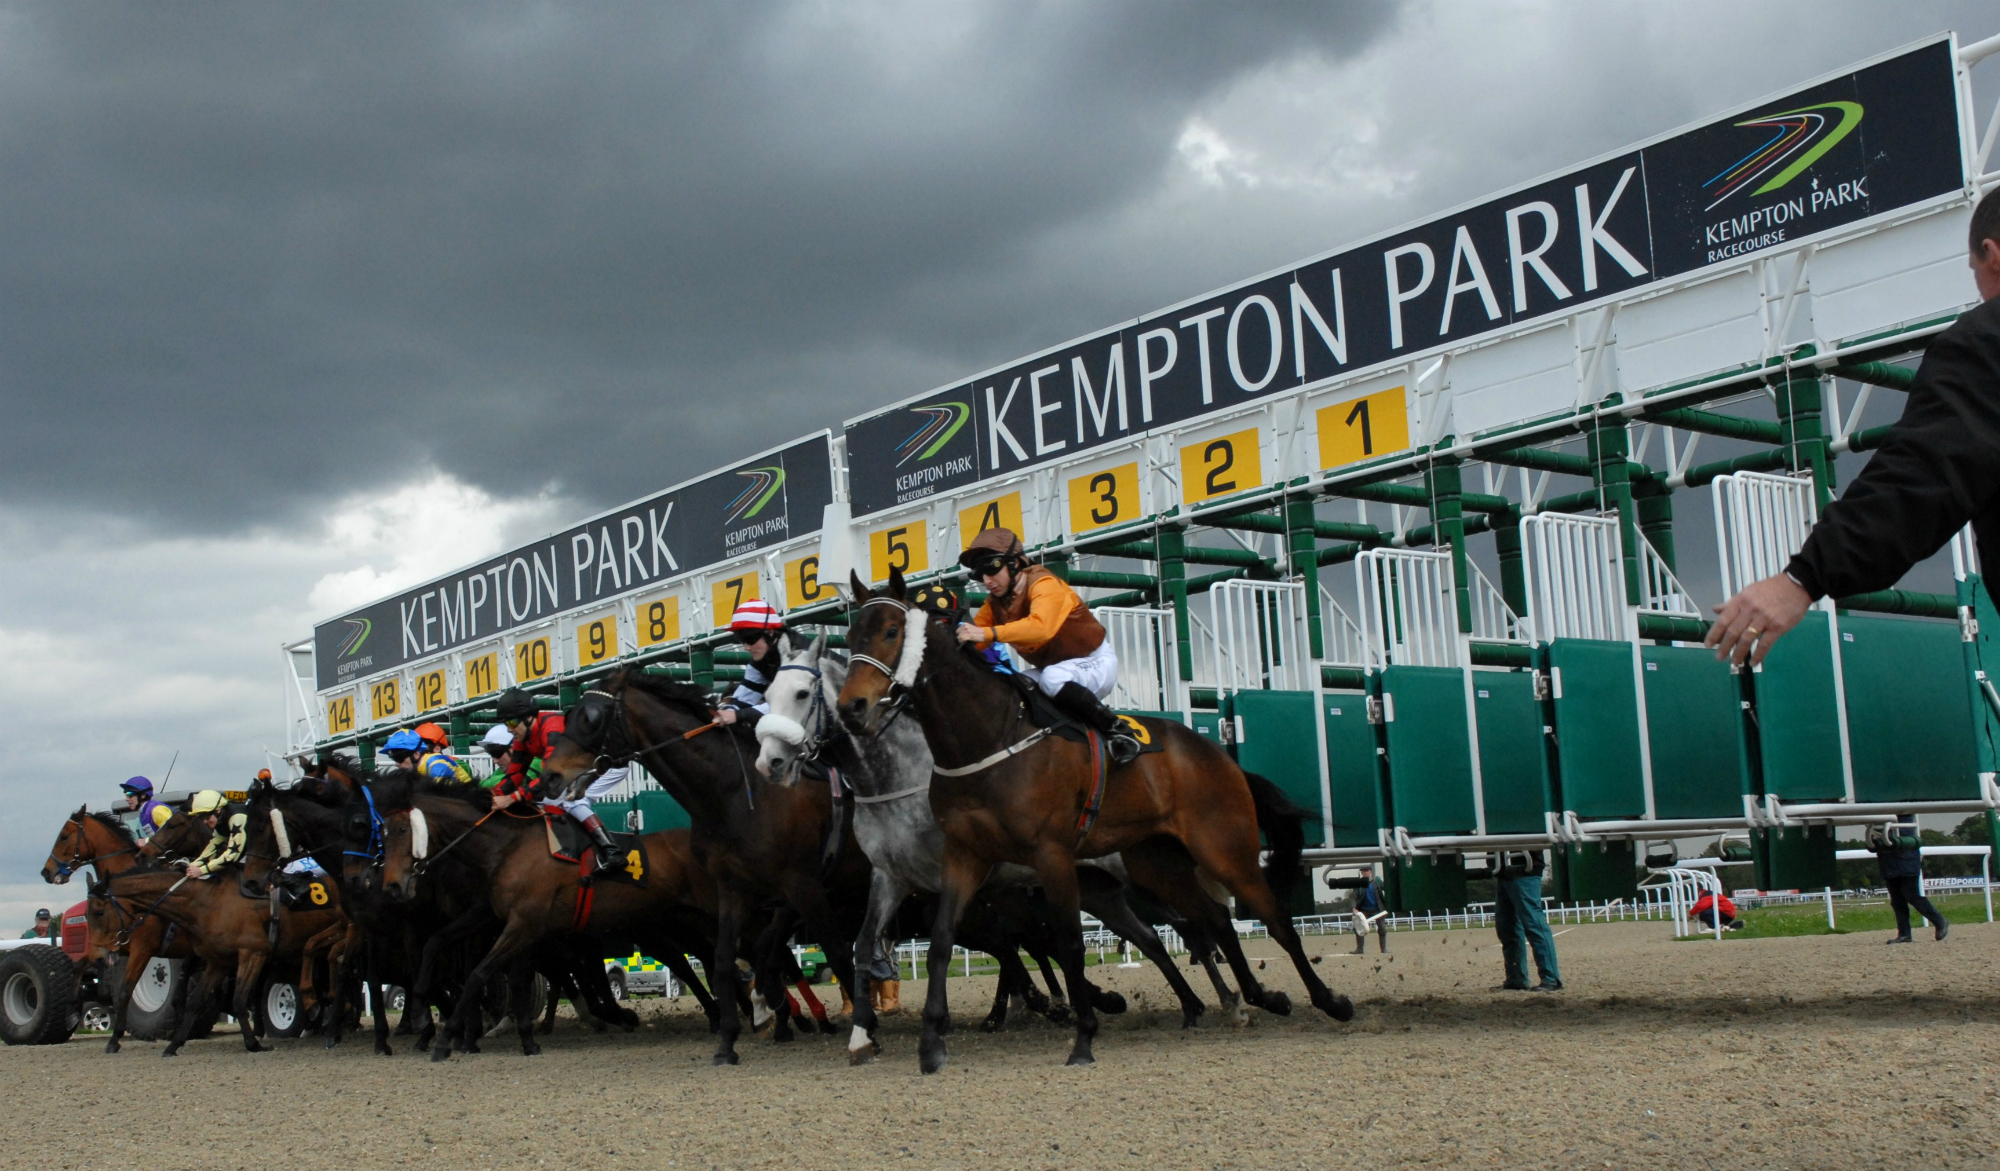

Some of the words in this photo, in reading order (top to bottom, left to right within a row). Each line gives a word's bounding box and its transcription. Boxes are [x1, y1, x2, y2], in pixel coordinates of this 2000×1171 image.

[1706, 197, 1804, 246] KEMPTON
[1811, 176, 1869, 213] PARK
[1707, 228, 1786, 263] RACECOURSE
[985, 267, 1348, 470] KEMPTON
[1384, 165, 1649, 350] PARK
[1345, 399, 1374, 456] 1
[896, 465, 943, 492] KEMPTON
[945, 455, 972, 477] PARK
[1203, 439, 1237, 497] 2
[897, 485, 935, 504] RACECOURSE
[1089, 472, 1119, 525] 3
[725, 522, 764, 548] KEMPTON
[765, 514, 788, 534] PARK
[726, 541, 757, 558] RACECOURSE
[887, 527, 910, 573] 5
[400, 545, 559, 660] KEMPTON
[572, 501, 679, 602] PARK
[725, 577, 743, 615] 7
[800, 556, 820, 601] 6
[588, 621, 606, 660] 9
[649, 601, 666, 642] 8
[337, 659, 361, 676] KEMPTON
[360, 655, 373, 669] PARK
[469, 656, 491, 694] 11
[519, 639, 547, 679] 10
[373, 681, 396, 717] 13
[417, 672, 442, 709] 12
[329, 698, 351, 732] 14
[624, 849, 644, 881] 4
[1921, 877, 1984, 887] ETFREDPOKER
[309, 882, 329, 906] 8
